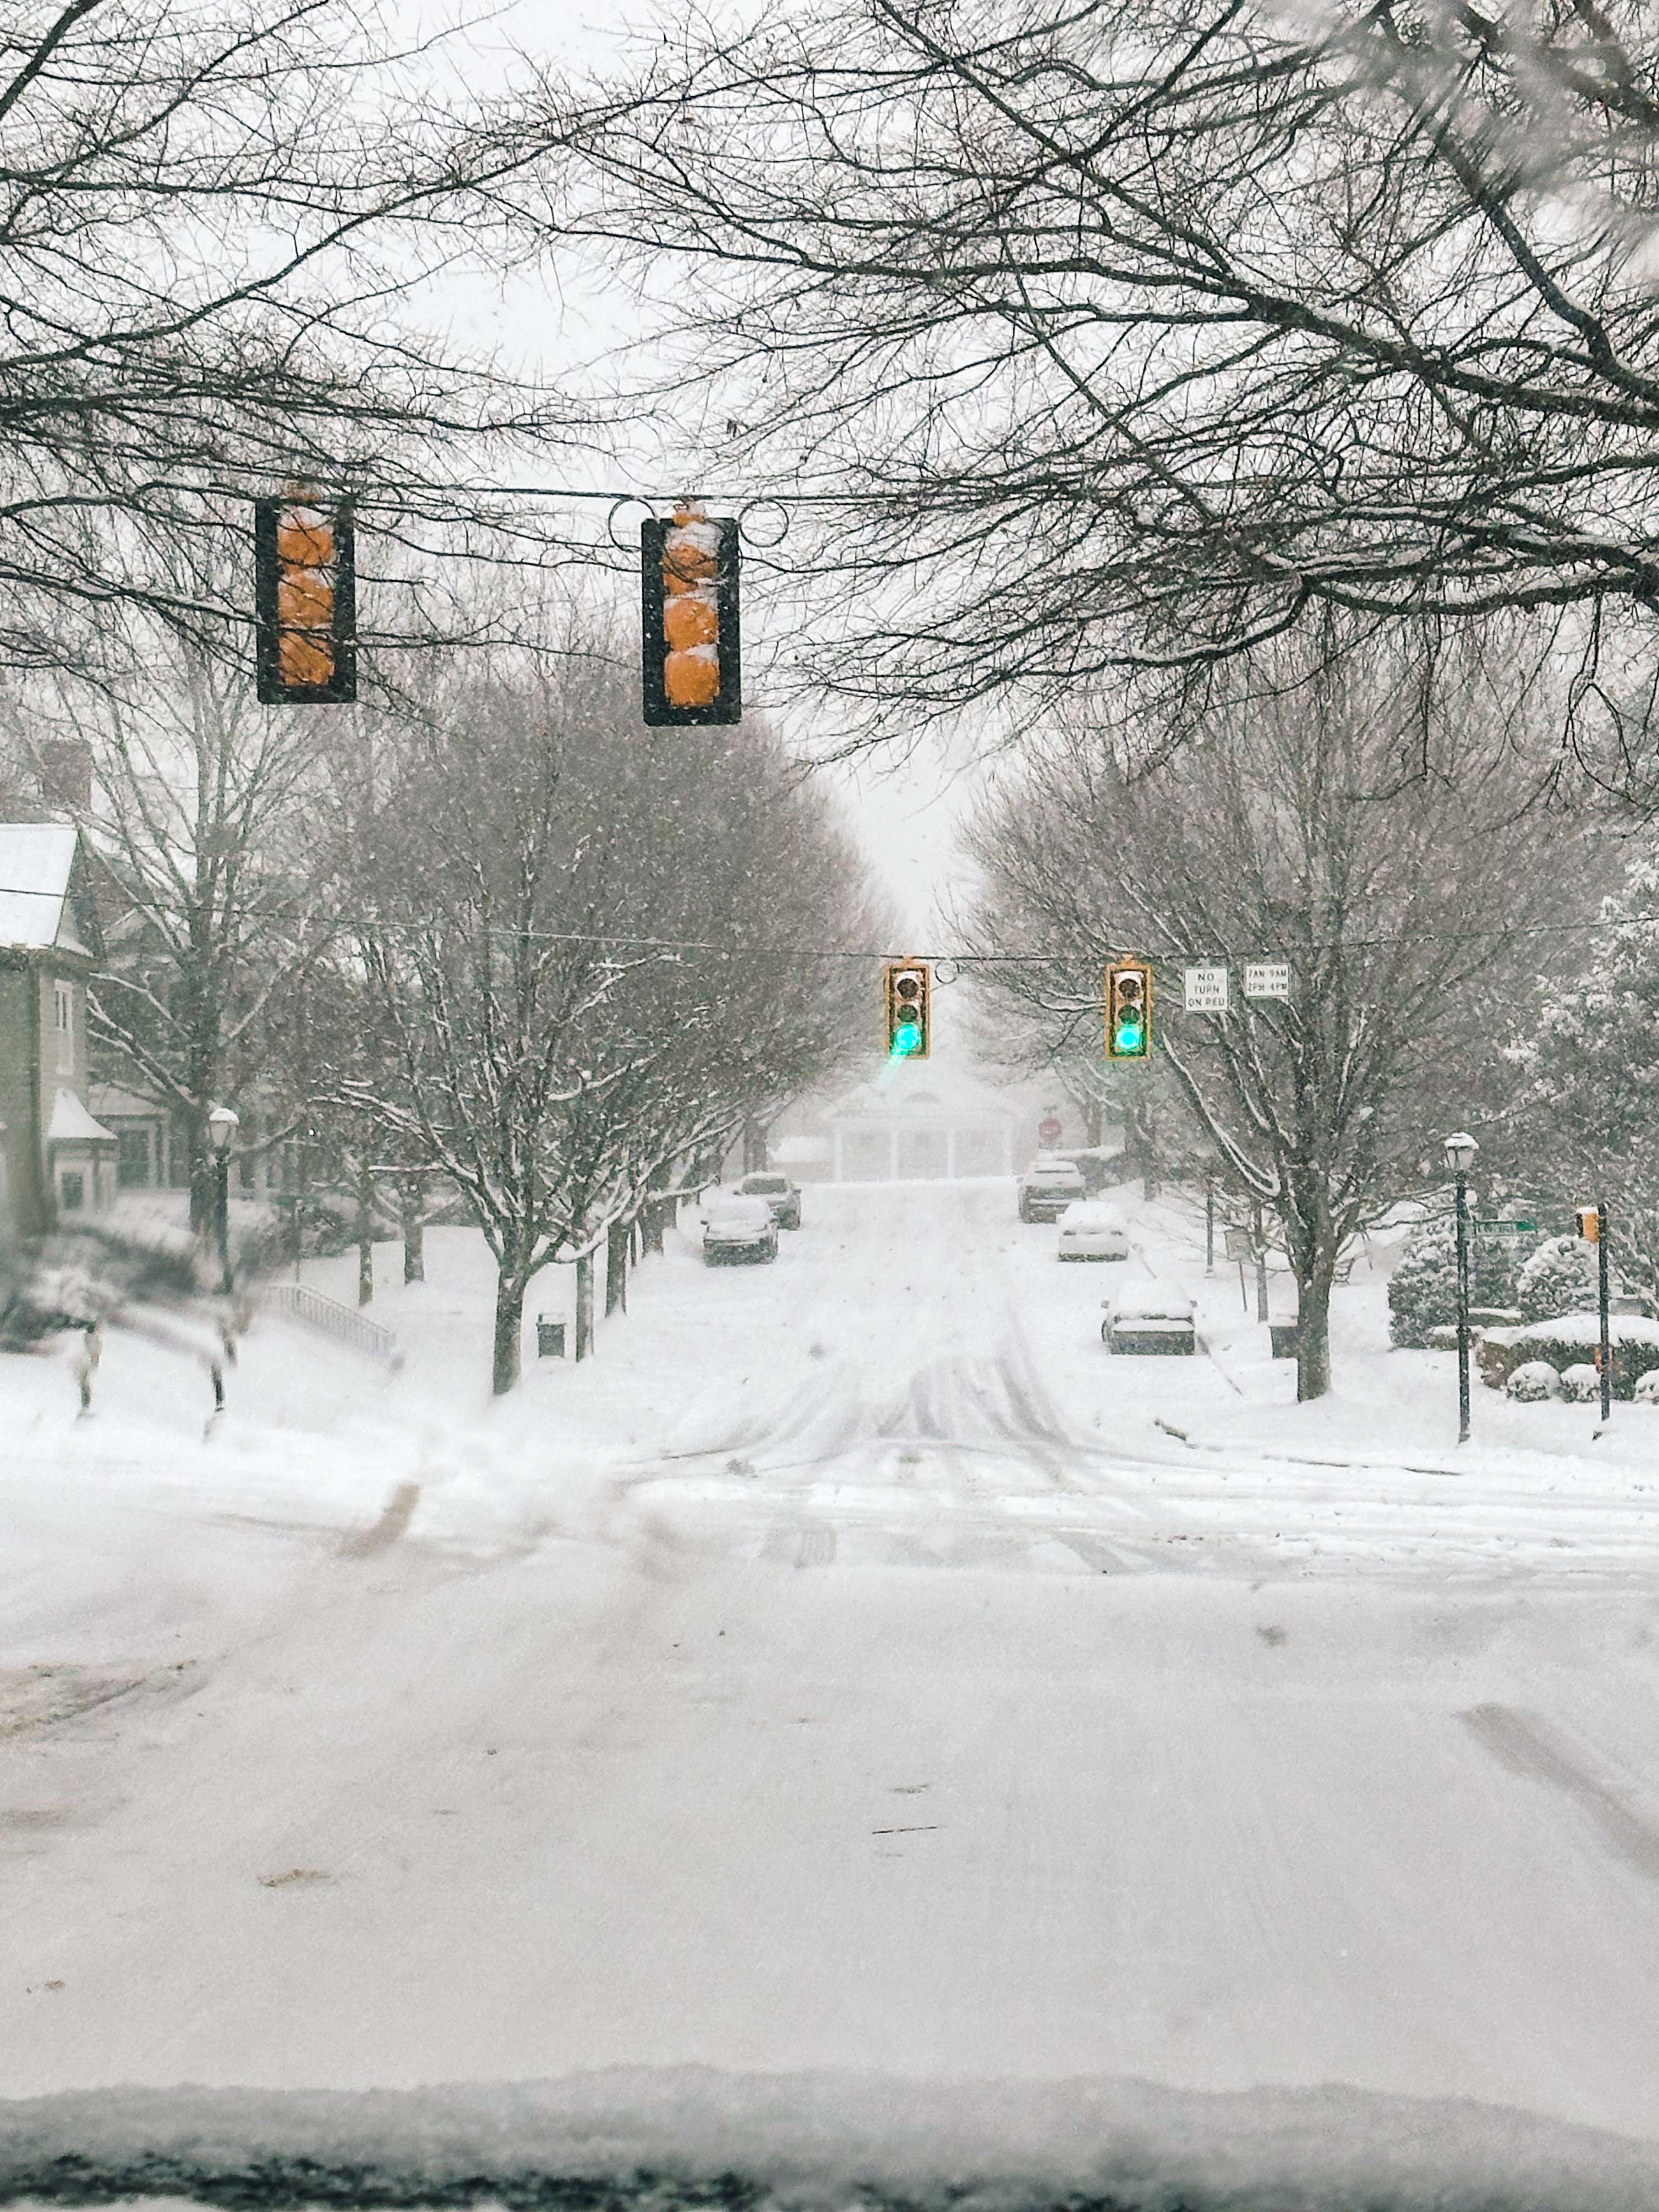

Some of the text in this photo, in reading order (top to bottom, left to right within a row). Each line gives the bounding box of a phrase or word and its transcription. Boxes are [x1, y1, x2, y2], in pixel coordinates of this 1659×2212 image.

[1194, 984, 1219, 994] TURN
[1188, 997, 1224, 1007] ON RED
